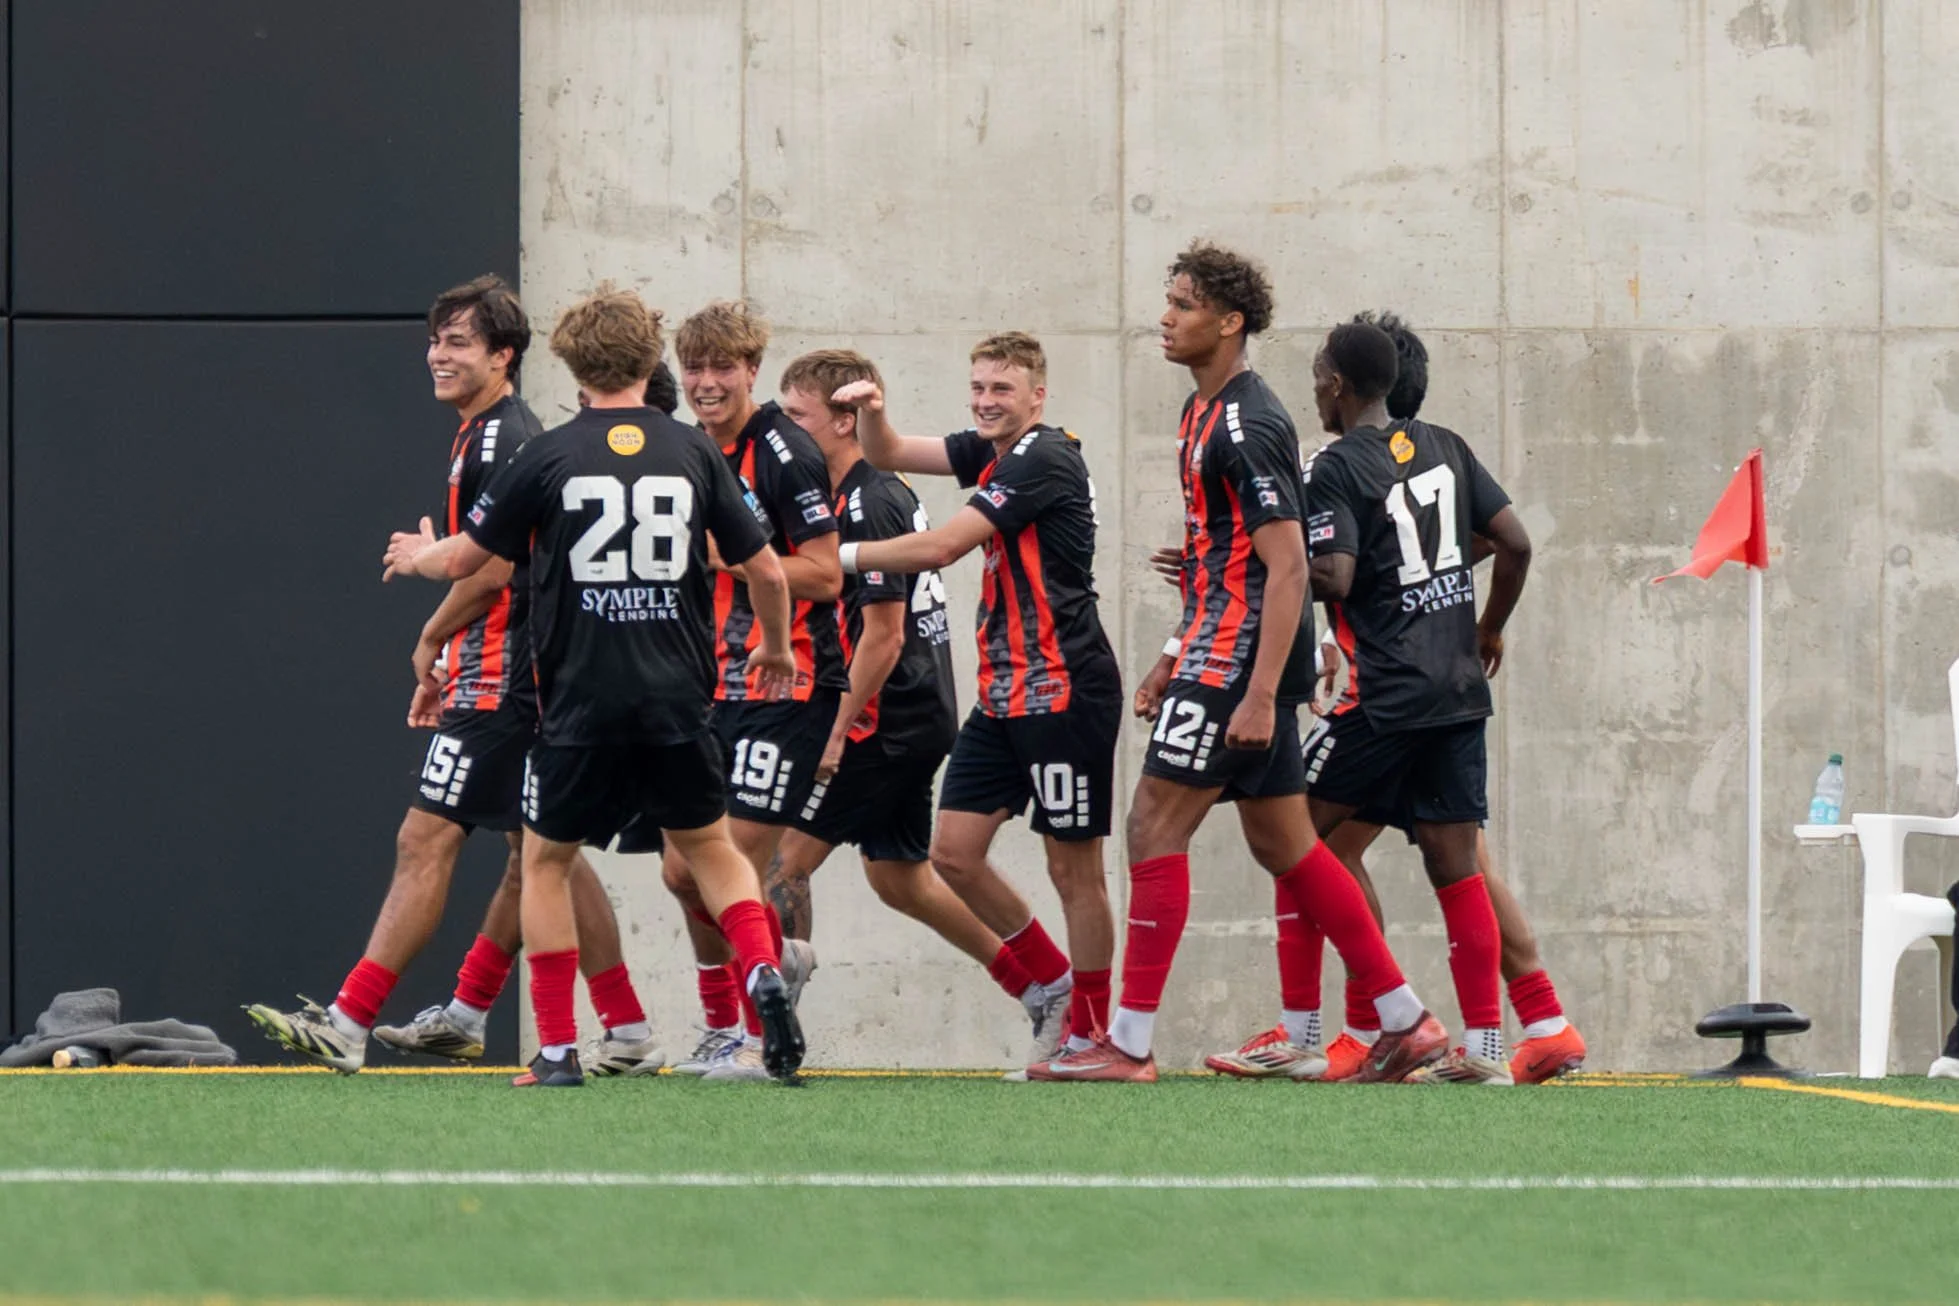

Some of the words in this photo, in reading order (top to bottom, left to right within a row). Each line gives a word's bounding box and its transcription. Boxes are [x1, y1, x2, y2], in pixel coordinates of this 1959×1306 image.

[561, 475, 693, 582] 28
[1385, 463, 1462, 586] 17
[581, 588, 680, 617] SYMPLE
[608, 608, 679, 622] LENDING
[1153, 696, 1206, 751] 12
[421, 733, 462, 785] 15
[731, 738, 779, 790] 19
[1030, 763, 1073, 811] 10
